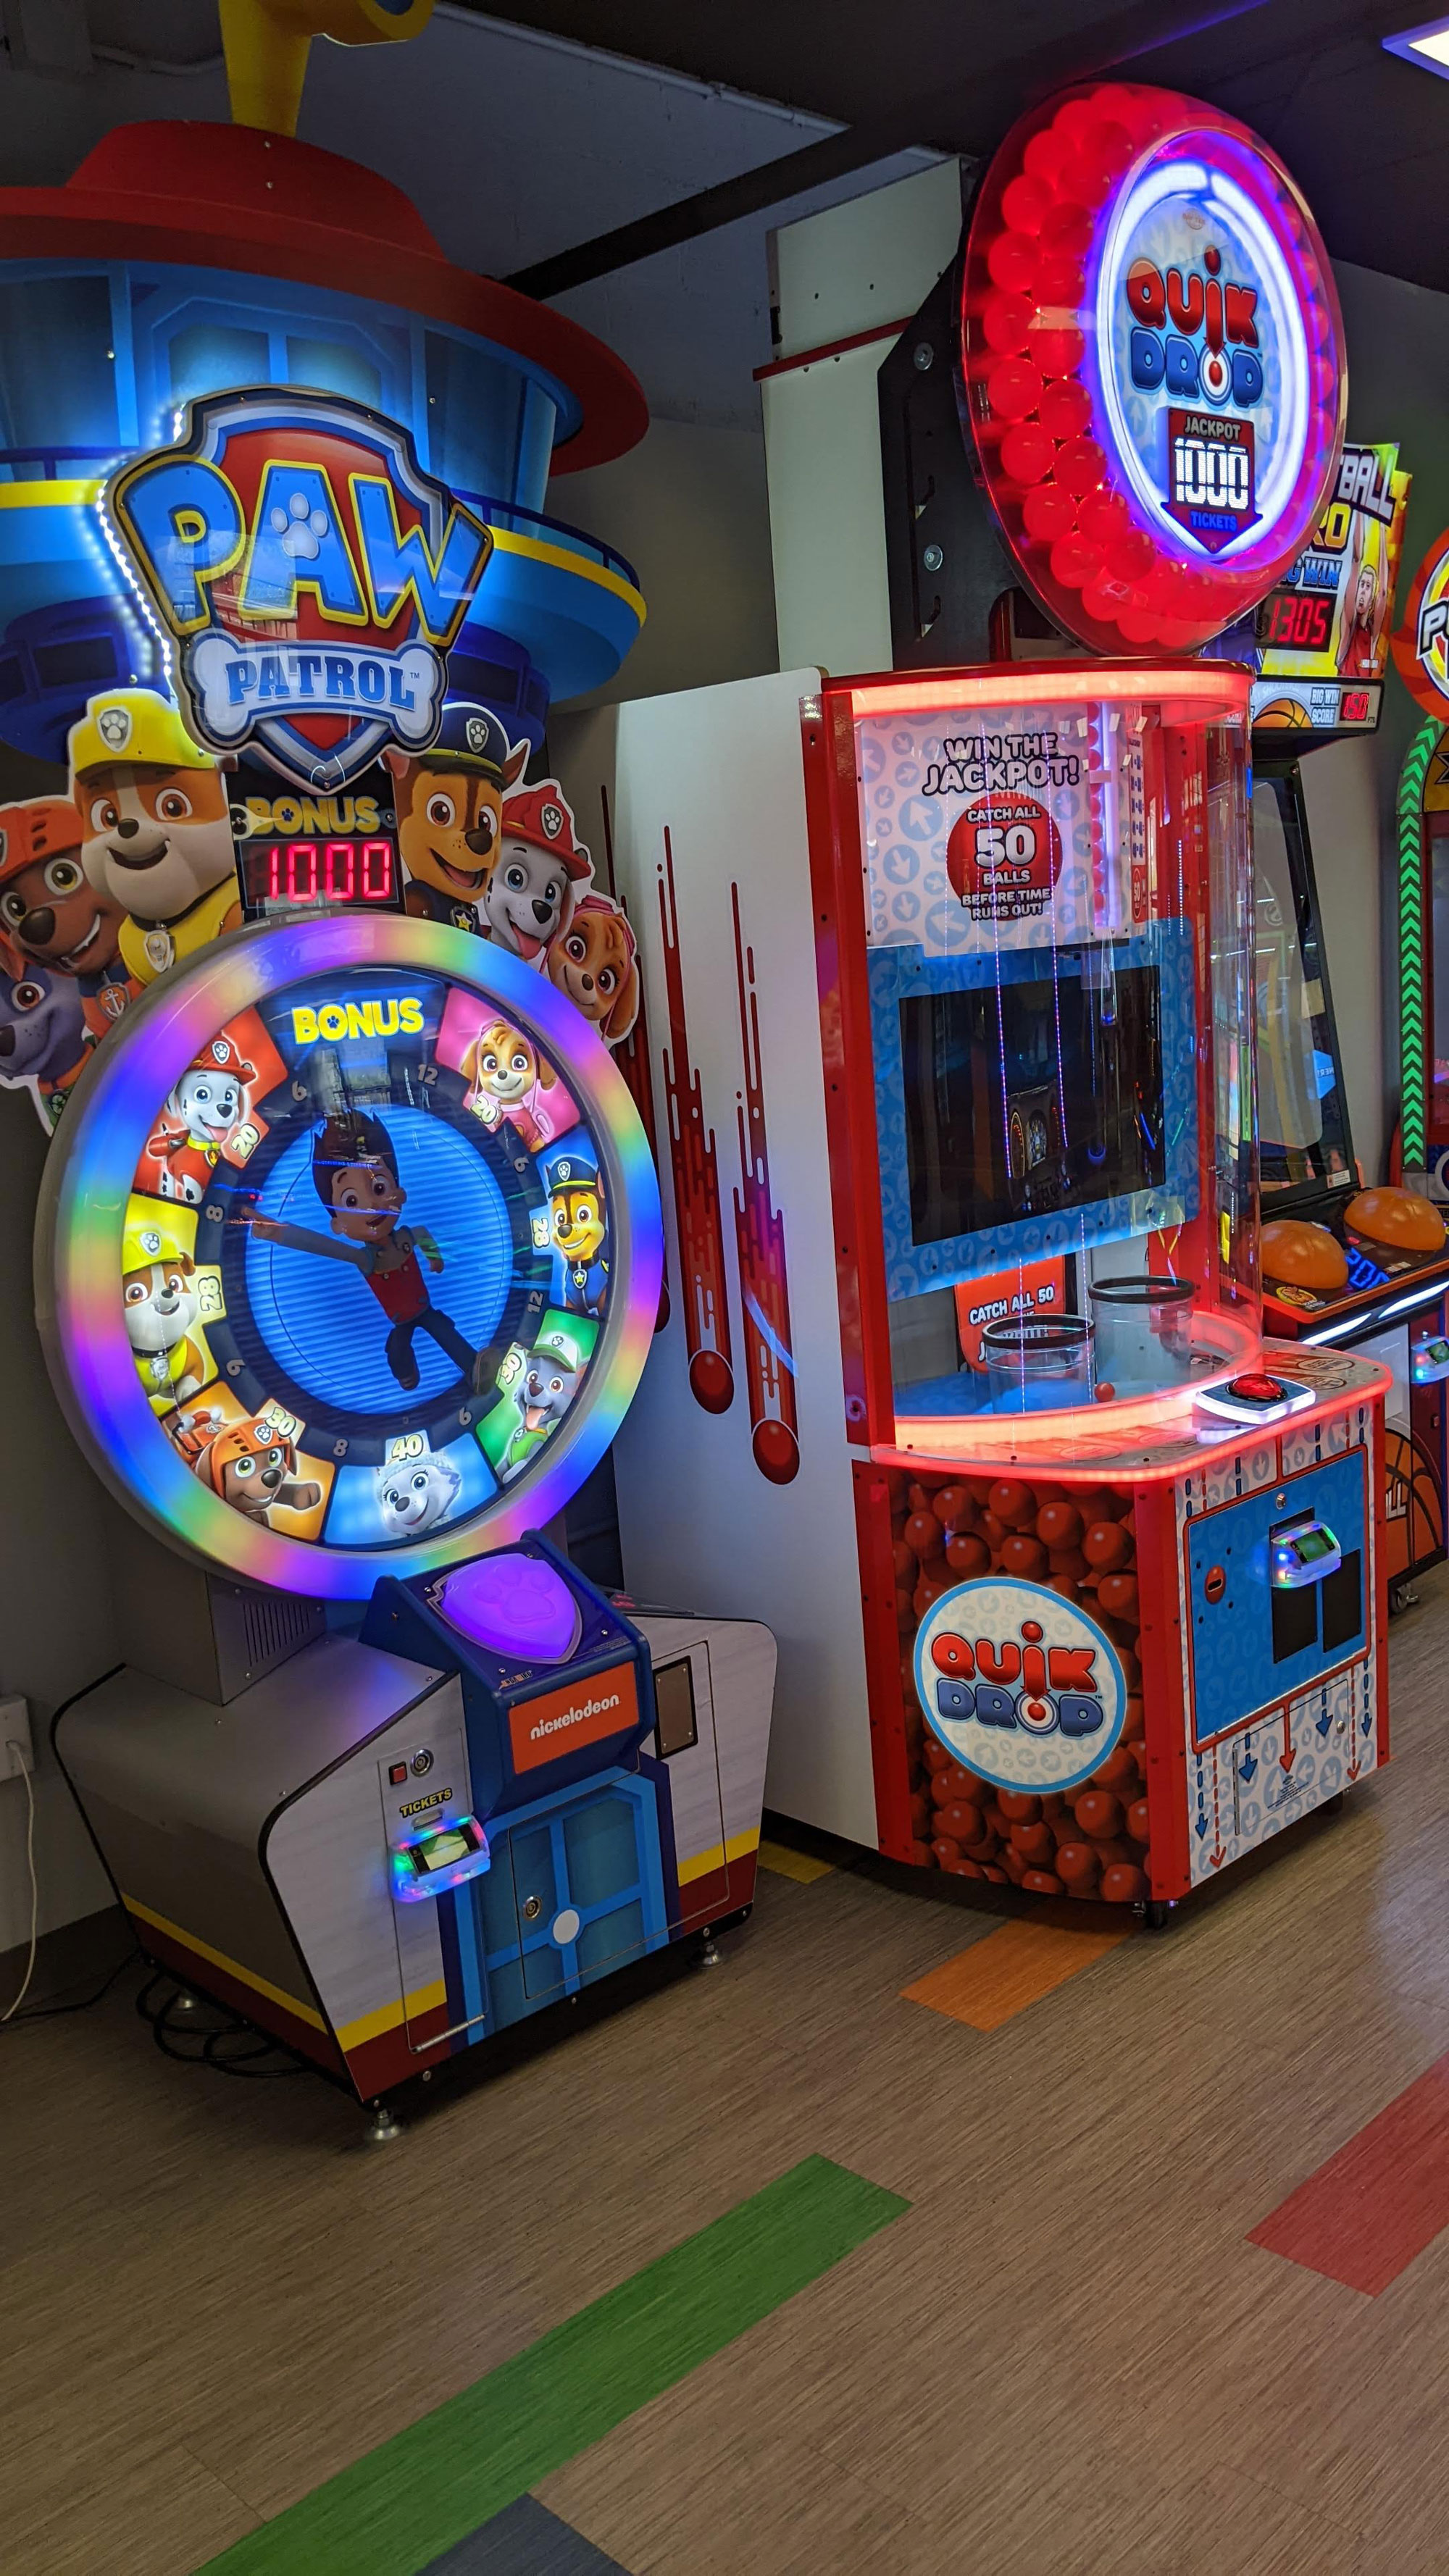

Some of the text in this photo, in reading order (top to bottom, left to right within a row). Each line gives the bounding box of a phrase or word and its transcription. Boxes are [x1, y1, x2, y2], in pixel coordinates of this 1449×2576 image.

[1127, 245, 1258, 352] QUIK
[1131, 327, 1263, 407] DROP
[1185, 415, 1240, 440] JACKPOT
[1174, 438, 1248, 509] 1000
[1337, 451, 1395, 523] BALL
[1190, 511, 1237, 531] TICKETS
[115, 454, 493, 646] PAW
[1303, 556, 1342, 588] WIN
[1269, 596, 1329, 644] 1305
[225, 656, 416, 710] PATROL
[1311, 687, 1324, 705] BIG
[1324, 687, 1340, 706] WIN
[1311, 707, 1335, 724] SCORE
[944, 732, 1058, 761] WIN THE
[922, 755, 1080, 796] JACKPOT!
[246, 796, 380, 835] BONUS
[966, 806, 1041, 823] CATCH ALL
[975, 823, 1037, 867] 50
[270, 842, 392, 902] 1000
[982, 870, 1030, 886] BALLS
[961, 888, 1051, 907] BEFORE TIME
[972, 903, 1043, 921] RUNS OUT!
[291, 998, 424, 1045] BONUS
[417, 1063, 439, 1085] 12
[291, 1080, 307, 1102] 6
[471, 1095, 500, 1124] 20
[230, 1124, 259, 1159] 20
[206, 1205, 223, 1223] 8
[532, 1218, 549, 1248] 28
[198, 1276, 222, 1311] 28
[527, 1291, 543, 1313] 12
[969, 1285, 1054, 1325] CATCH ALL 50
[265, 1407, 296, 1438] 30
[459, 1407, 471, 1426] 6
[333, 1439, 348, 1456] 8
[392, 1434, 424, 1460] 40
[1385, 1481, 1407, 1520] LL
[932, 1621, 1096, 1697] QUIK
[530, 1694, 620, 1740] nickelodeon
[937, 1678, 1103, 1736] DROP
[400, 1788, 452, 1818] TICKETS
